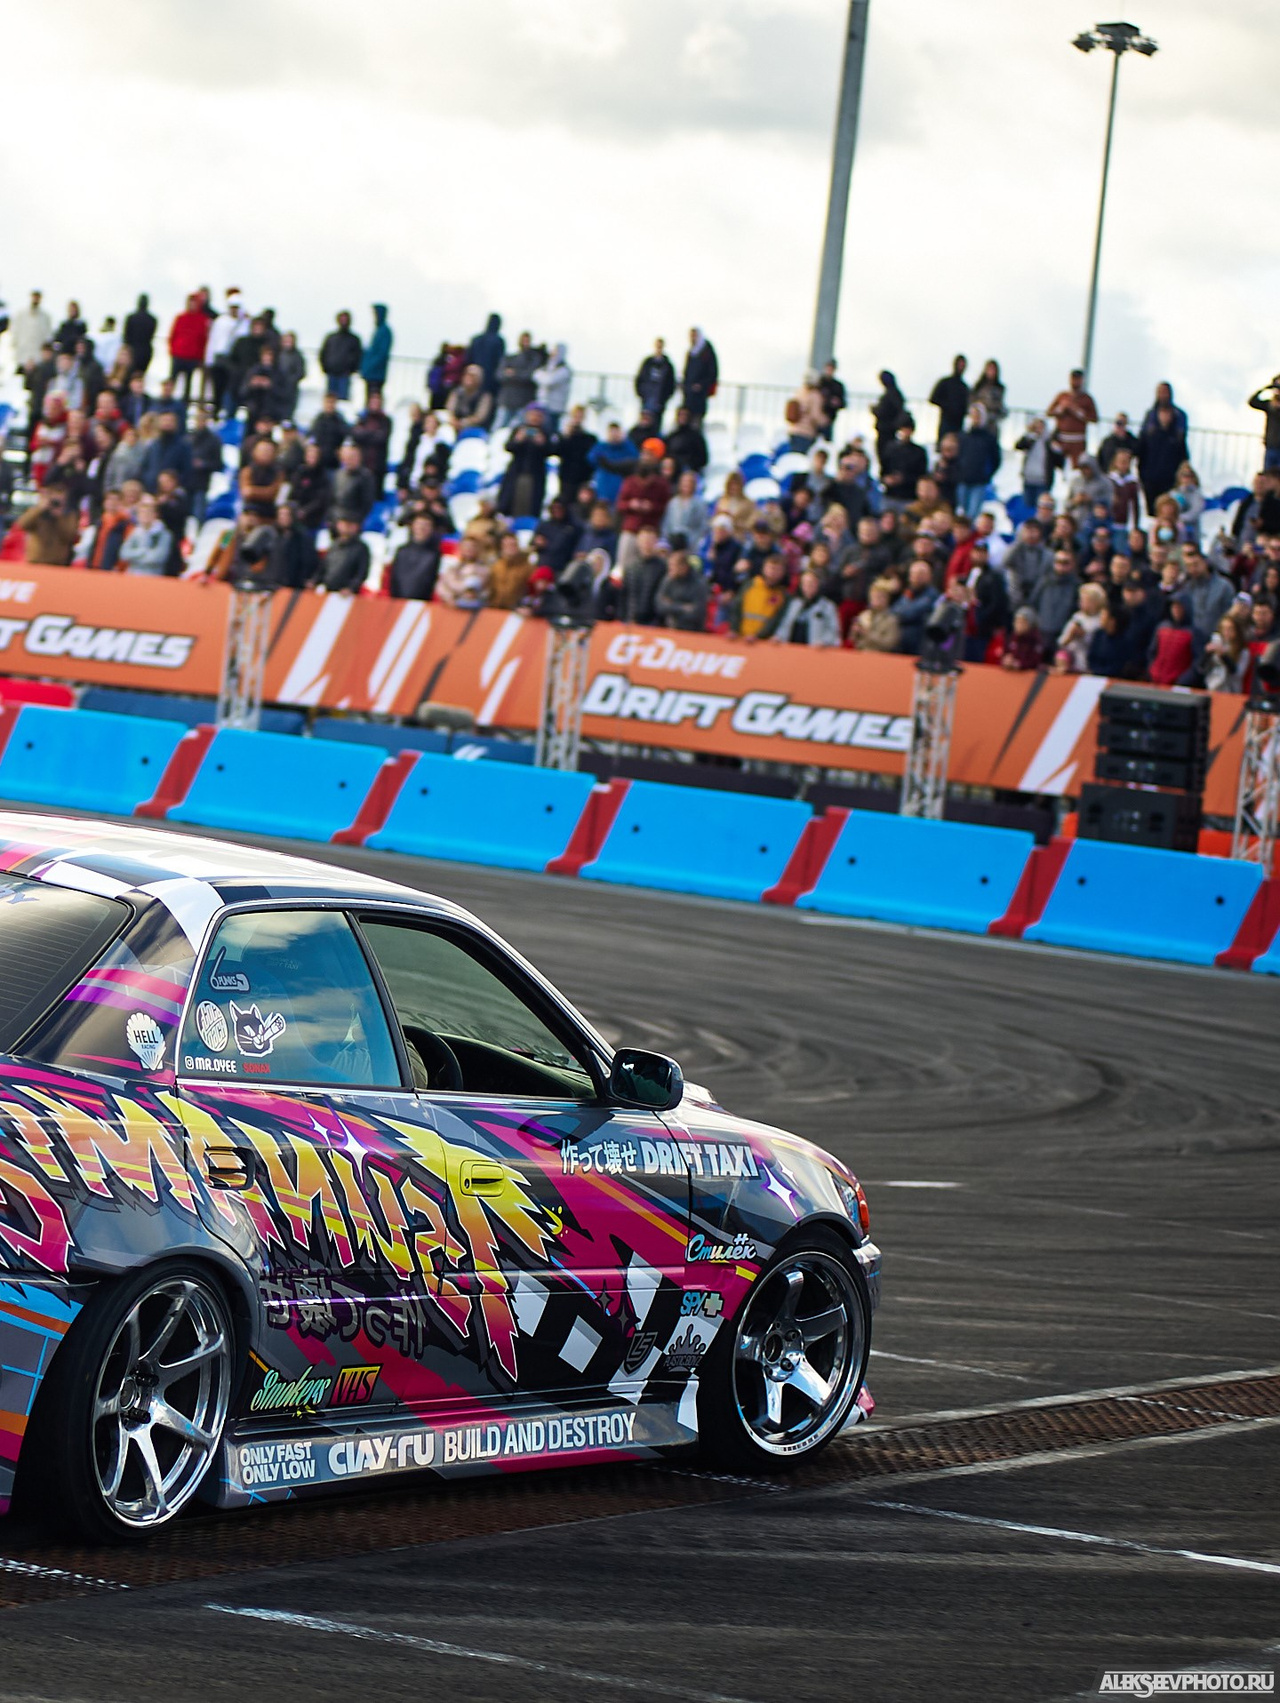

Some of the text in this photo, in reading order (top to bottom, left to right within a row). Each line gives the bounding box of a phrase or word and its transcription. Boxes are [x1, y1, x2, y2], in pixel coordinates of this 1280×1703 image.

[23, 613, 197, 668] GAMES
[582, 672, 913, 752] DRIFT GAMES
[133, 1028, 159, 1045] HELL
[195, 1058, 237, 1074] MR.OYEE
[561, 1139, 637, 1175] 作って壊せ
[643, 1141, 759, 1177] DRIFT TAXI
[336, 1368, 379, 1403] VHS
[240, 1441, 313, 1467] ONLY FAST
[443, 1412, 637, 1464] BUILD AND DESTROY
[242, 1459, 316, 1485] ONLY LOW
